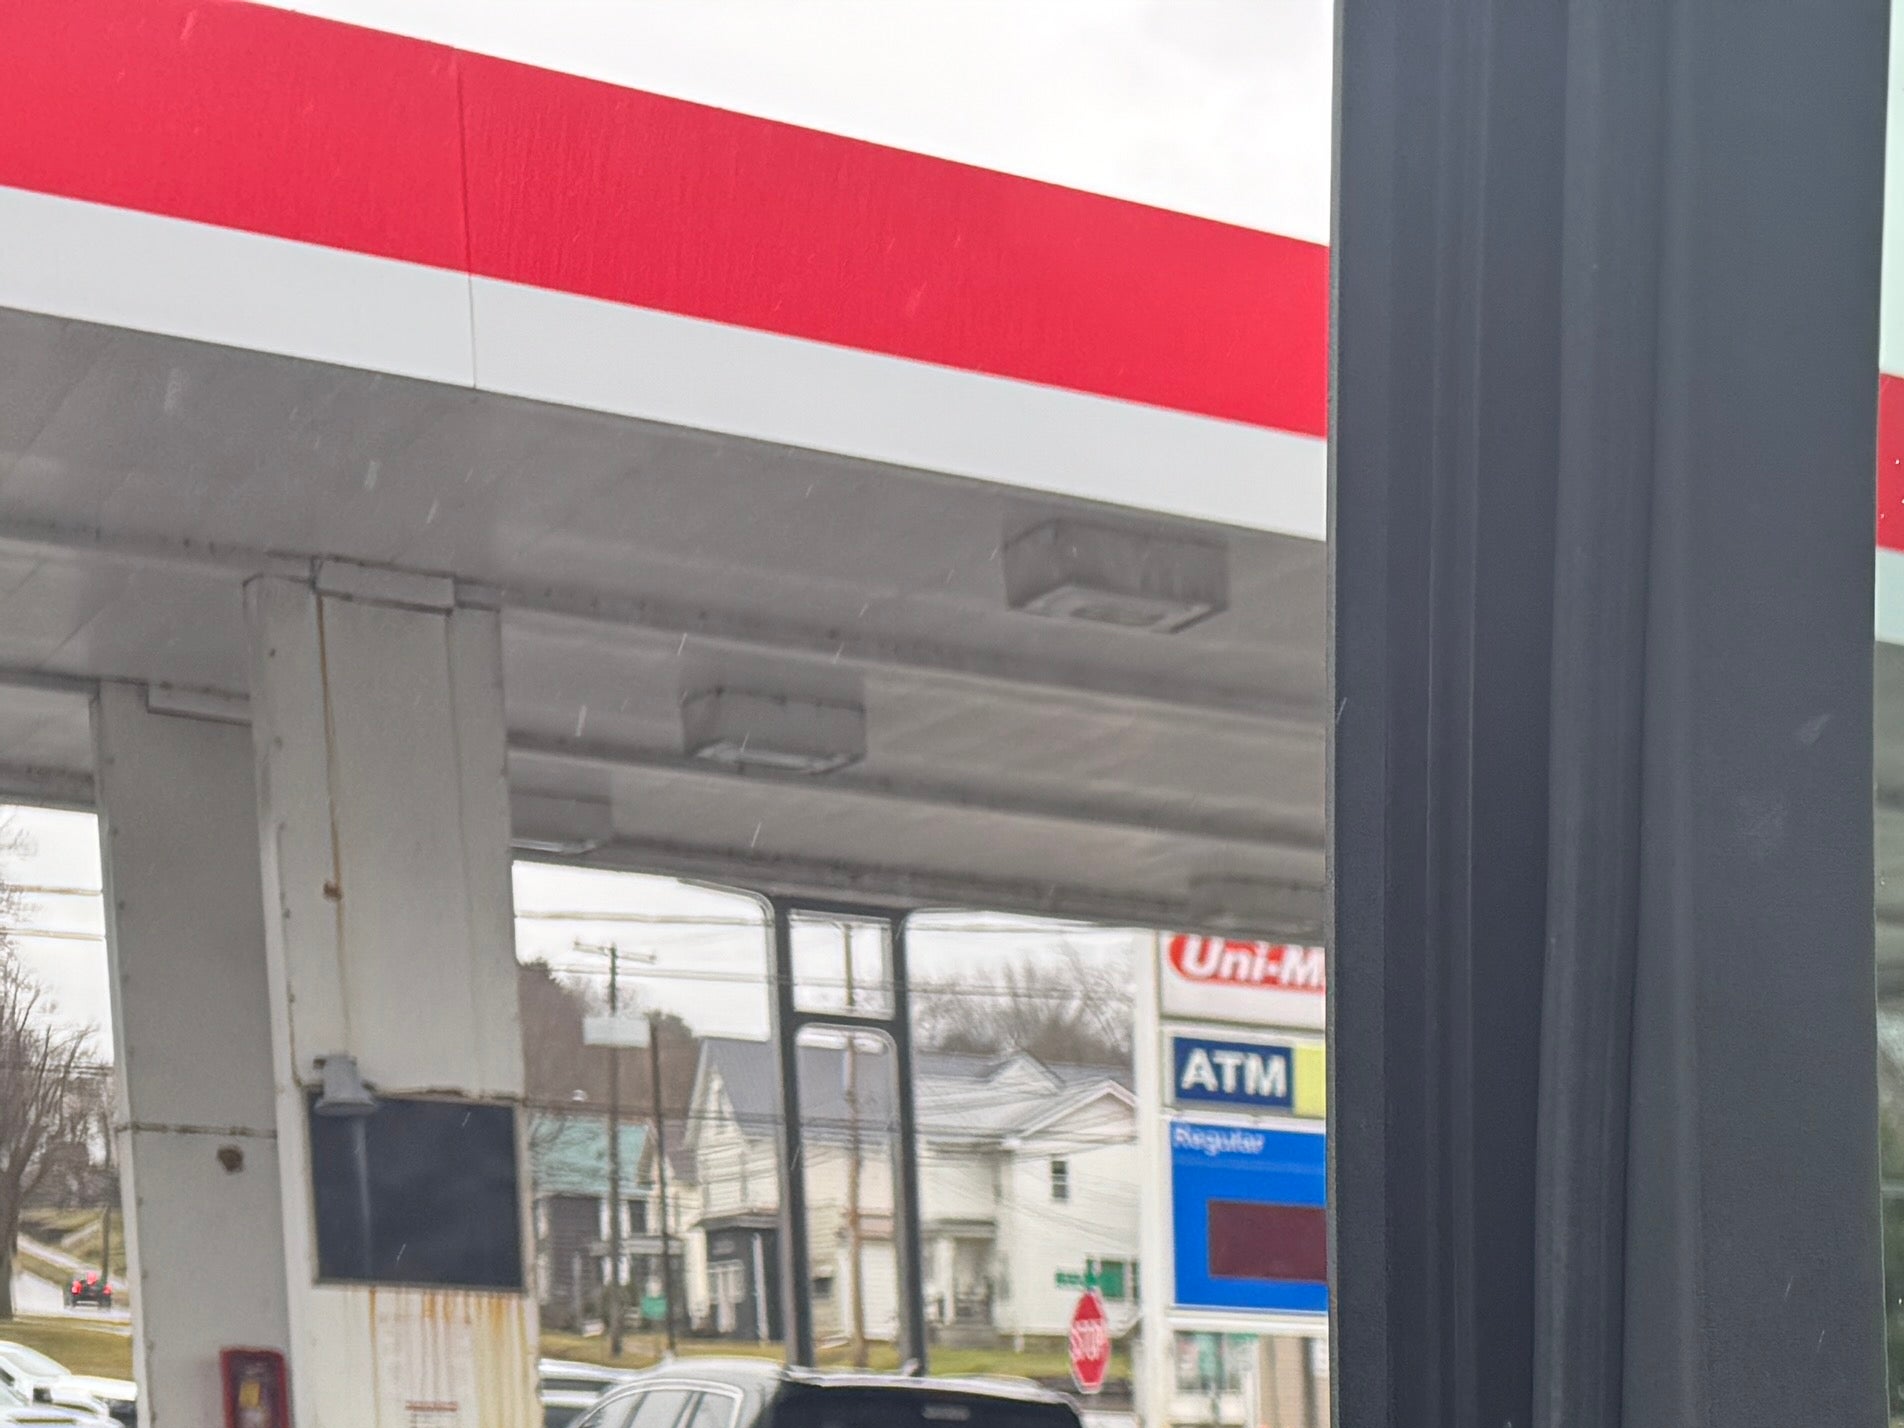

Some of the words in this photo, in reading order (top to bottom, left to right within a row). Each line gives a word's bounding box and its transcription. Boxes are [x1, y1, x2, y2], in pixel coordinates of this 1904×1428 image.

[1181, 934, 1325, 987] Uni-M
[1181, 1047, 1288, 1099] ATM
[1172, 1126, 1265, 1156] Regular
